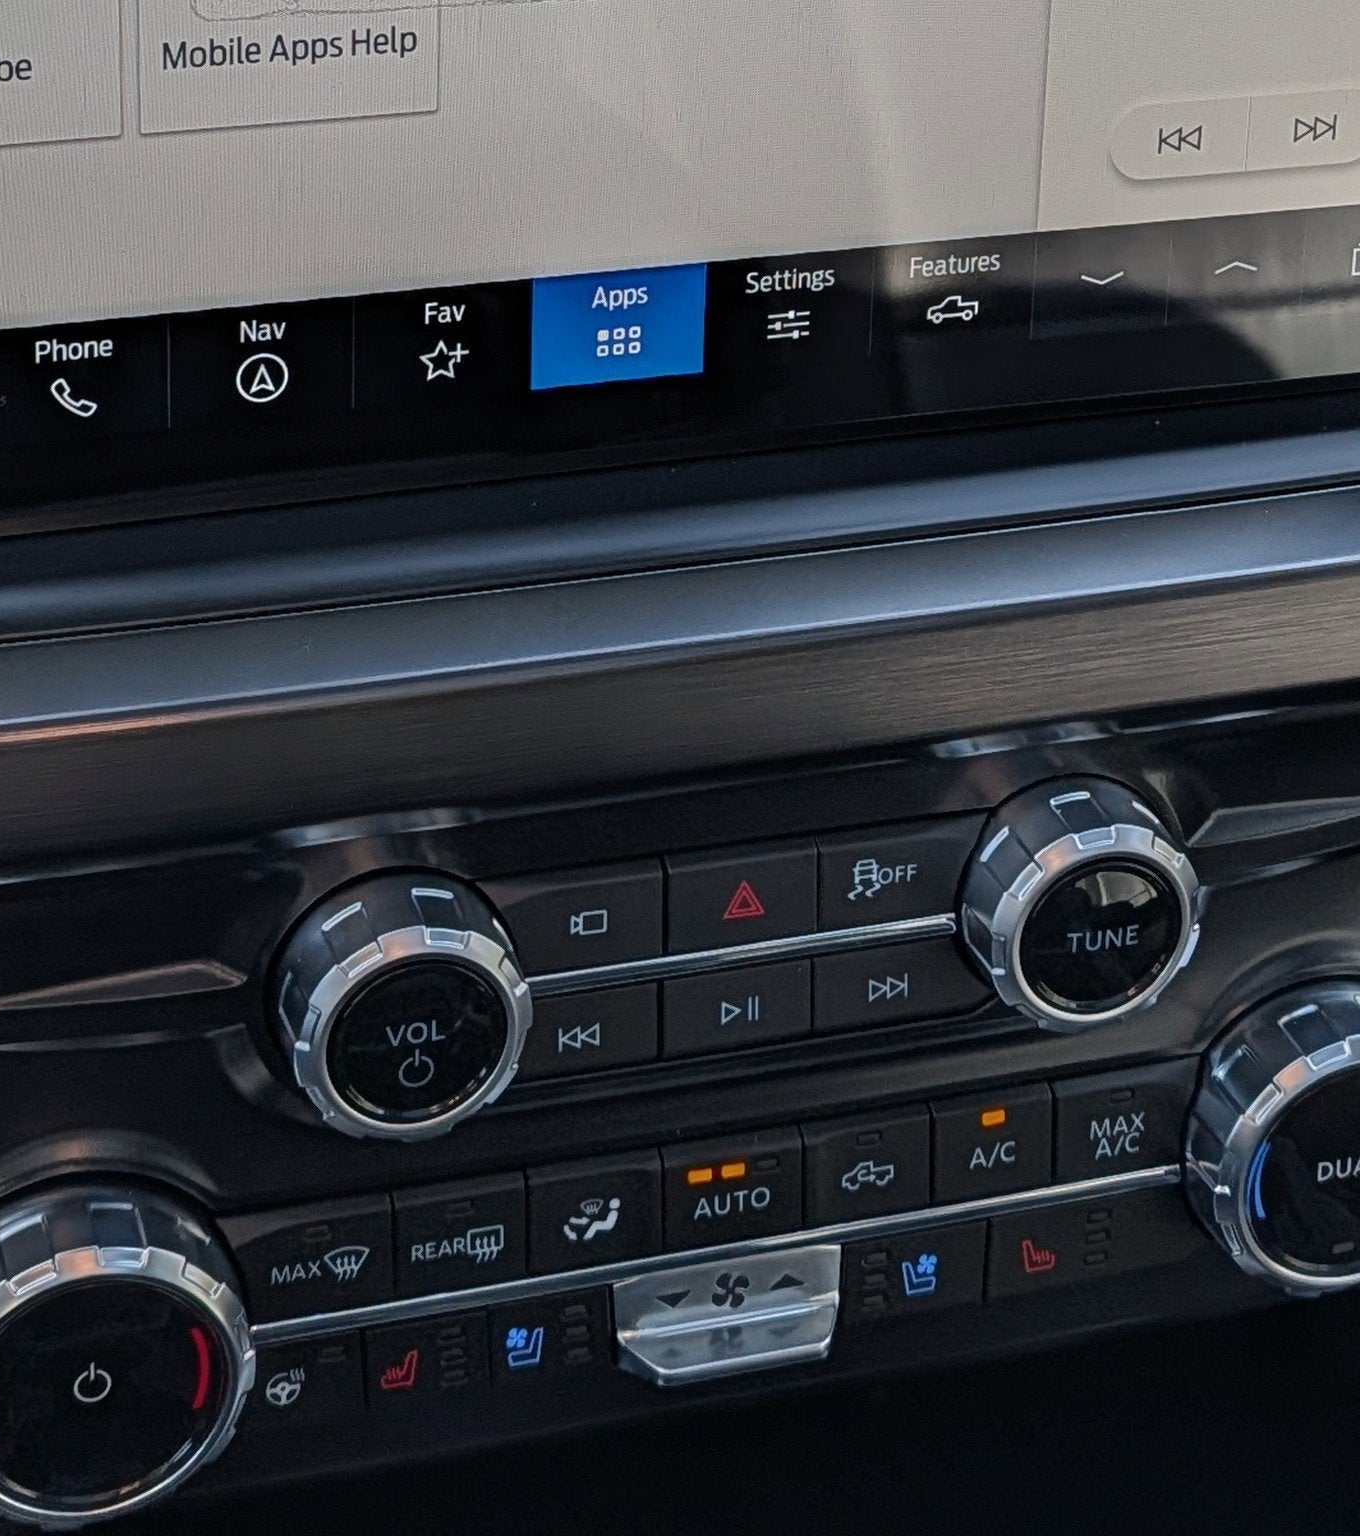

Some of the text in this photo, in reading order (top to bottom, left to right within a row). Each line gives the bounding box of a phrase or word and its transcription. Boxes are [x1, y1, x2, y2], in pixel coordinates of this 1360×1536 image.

[161, 25, 419, 71] Mobile Apps Help
[908, 250, 1002, 280] Features
[744, 265, 837, 297] Settings
[590, 284, 650, 311] Apps
[423, 301, 468, 327] Fav
[239, 319, 288, 344] Nav
[34, 335, 115, 365] Phone
[877, 862, 919, 886] OFF
[1066, 923, 1141, 955] TUNE
[384, 1019, 446, 1049] VOL
[1089, 1111, 1147, 1141] MAX
[969, 1140, 1017, 1172] A/C
[1093, 1131, 1141, 1160] A/C
[693, 1186, 772, 1221] AUTO
[409, 1237, 469, 1264] REAR
[269, 1260, 323, 1286] MAX
